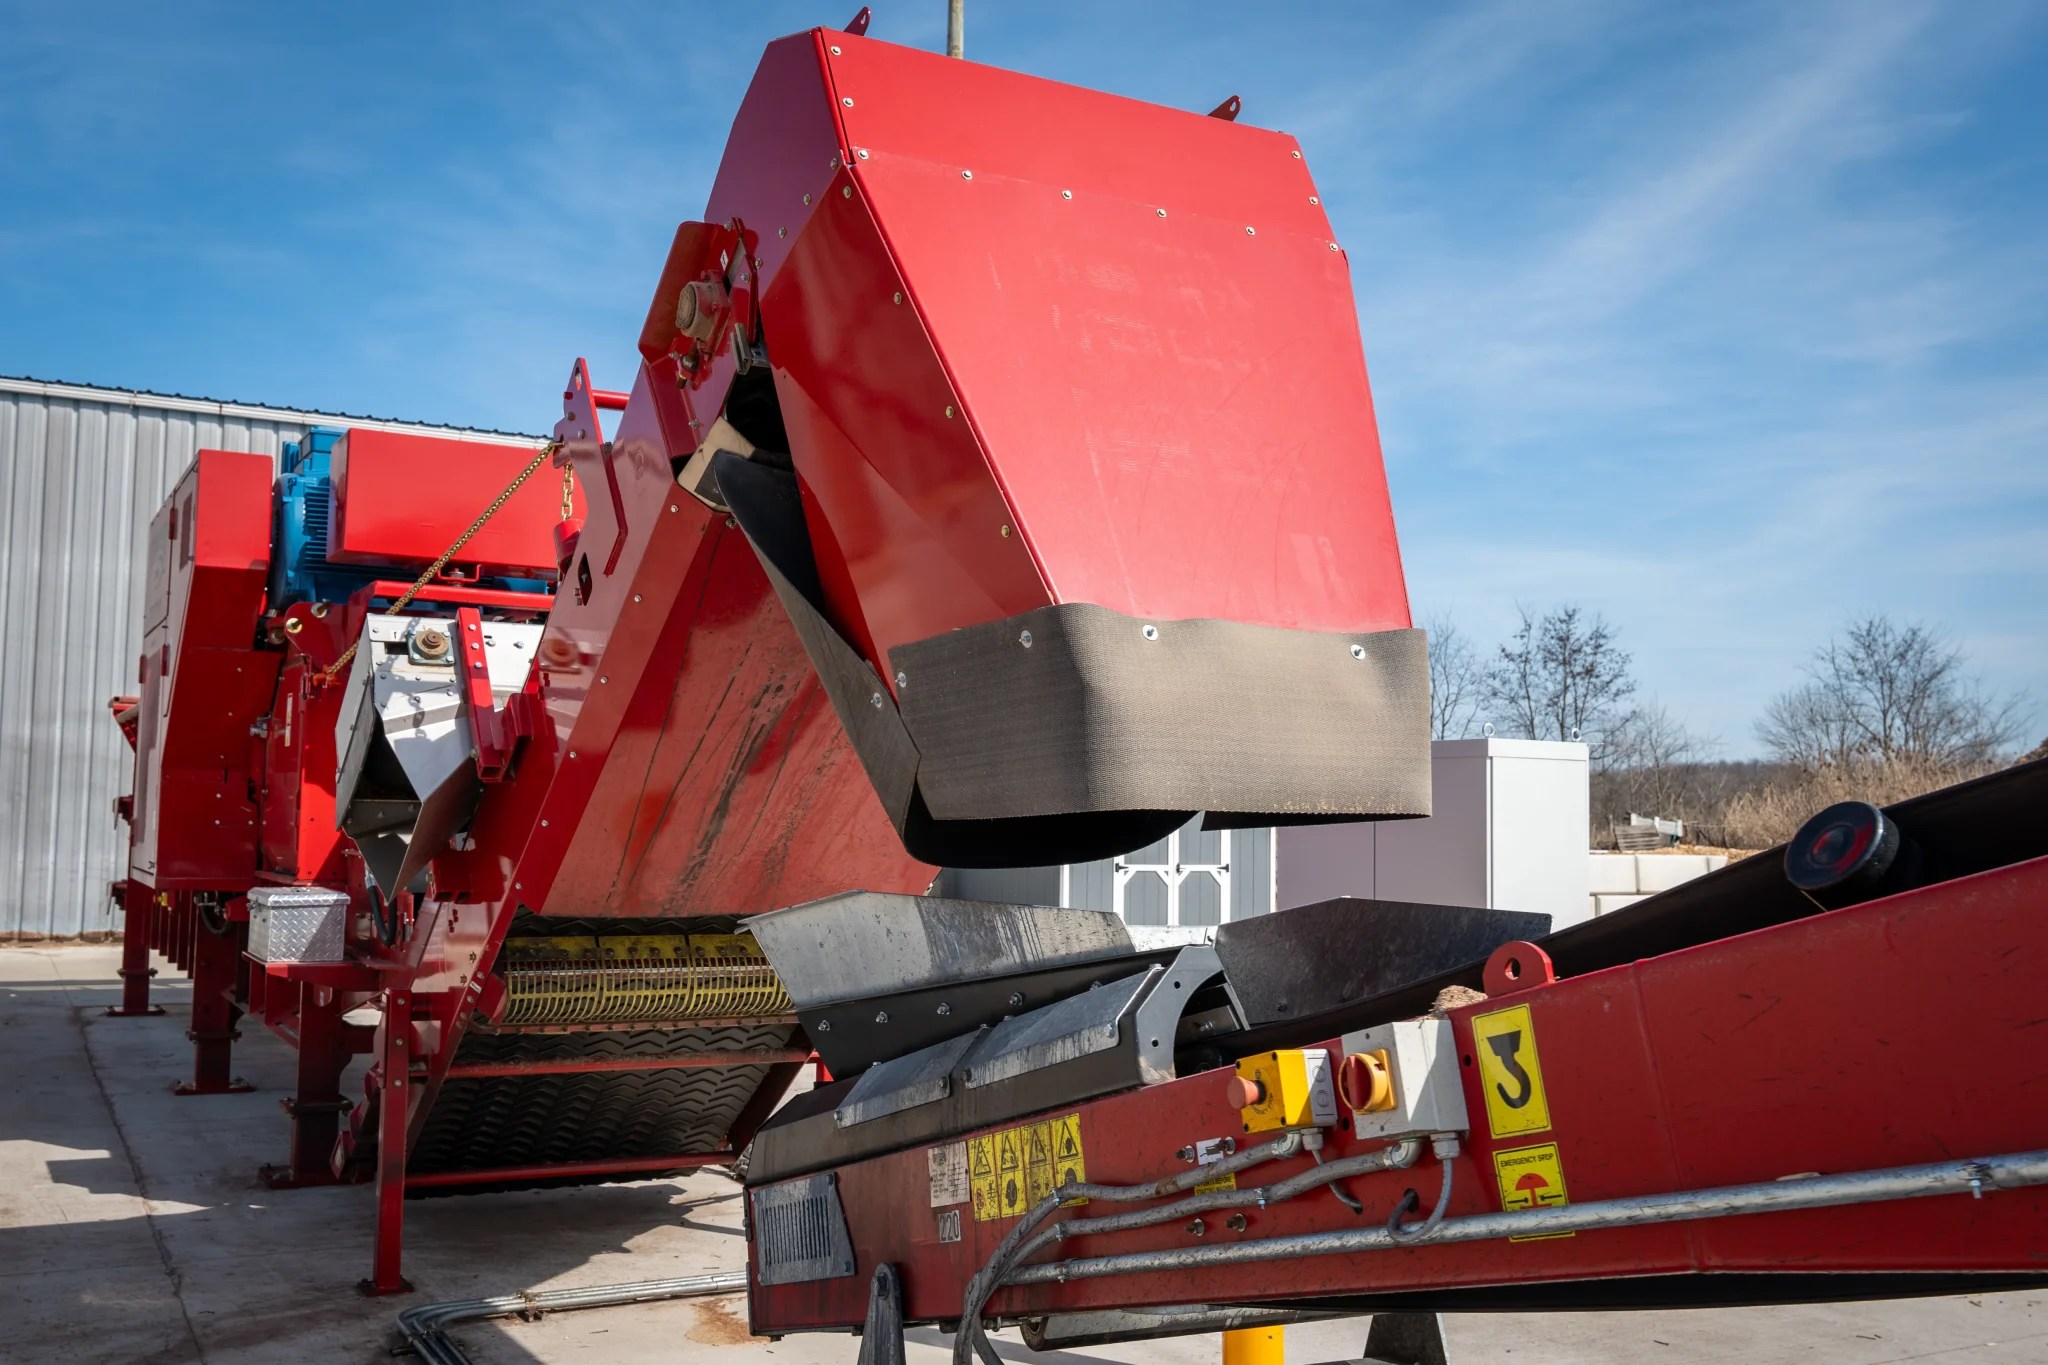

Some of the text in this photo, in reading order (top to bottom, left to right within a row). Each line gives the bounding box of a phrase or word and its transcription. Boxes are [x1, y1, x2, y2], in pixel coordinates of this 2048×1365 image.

[1500, 1153, 1553, 1167] EMERGENCY STOP
[940, 1212, 959, 1241] 220
